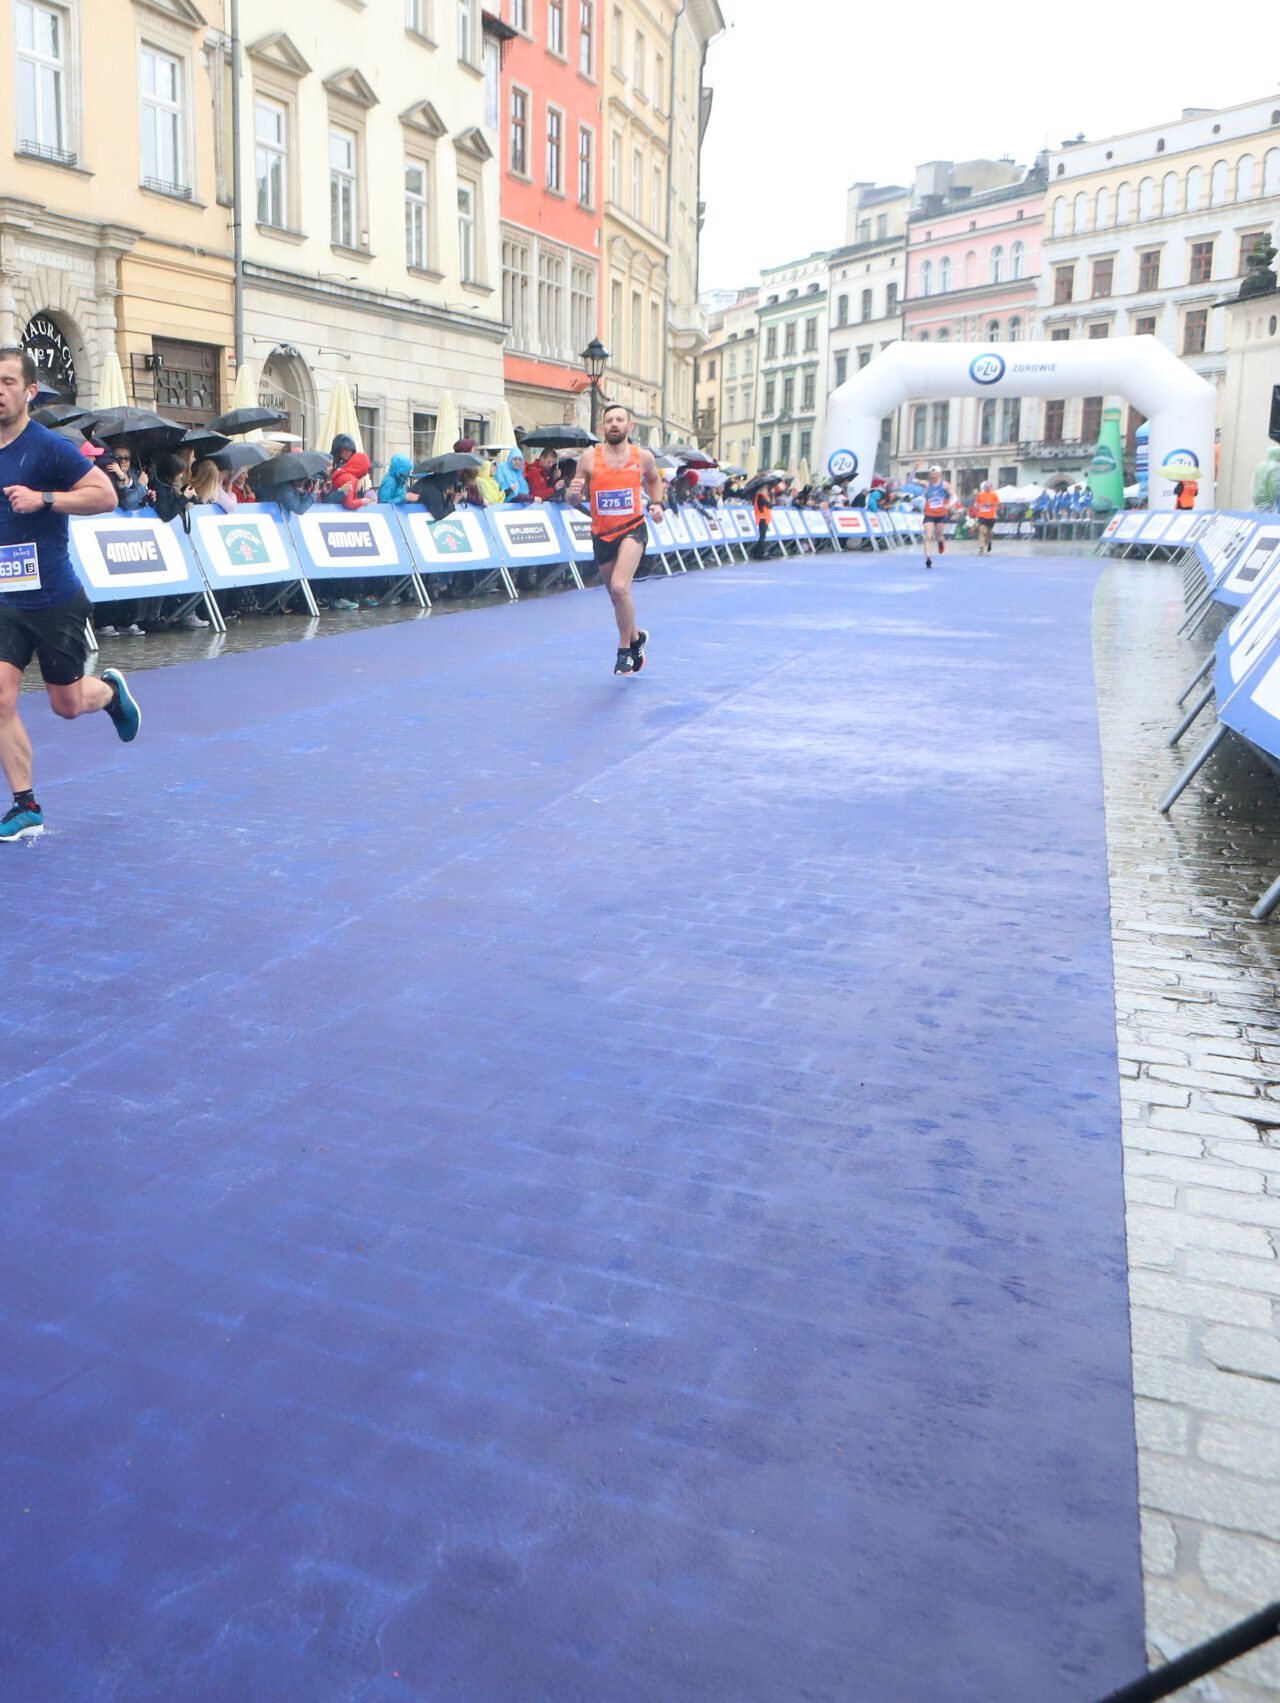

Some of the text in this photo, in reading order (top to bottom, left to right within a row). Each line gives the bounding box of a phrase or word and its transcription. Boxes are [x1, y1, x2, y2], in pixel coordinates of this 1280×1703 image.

[46, 348, 55, 368] 7
[1012, 363, 1057, 373] ZDROWIE
[601, 498, 621, 508] 275
[327, 531, 373, 548] 4MOVE
[107, 541, 158, 563] 4MOVE
